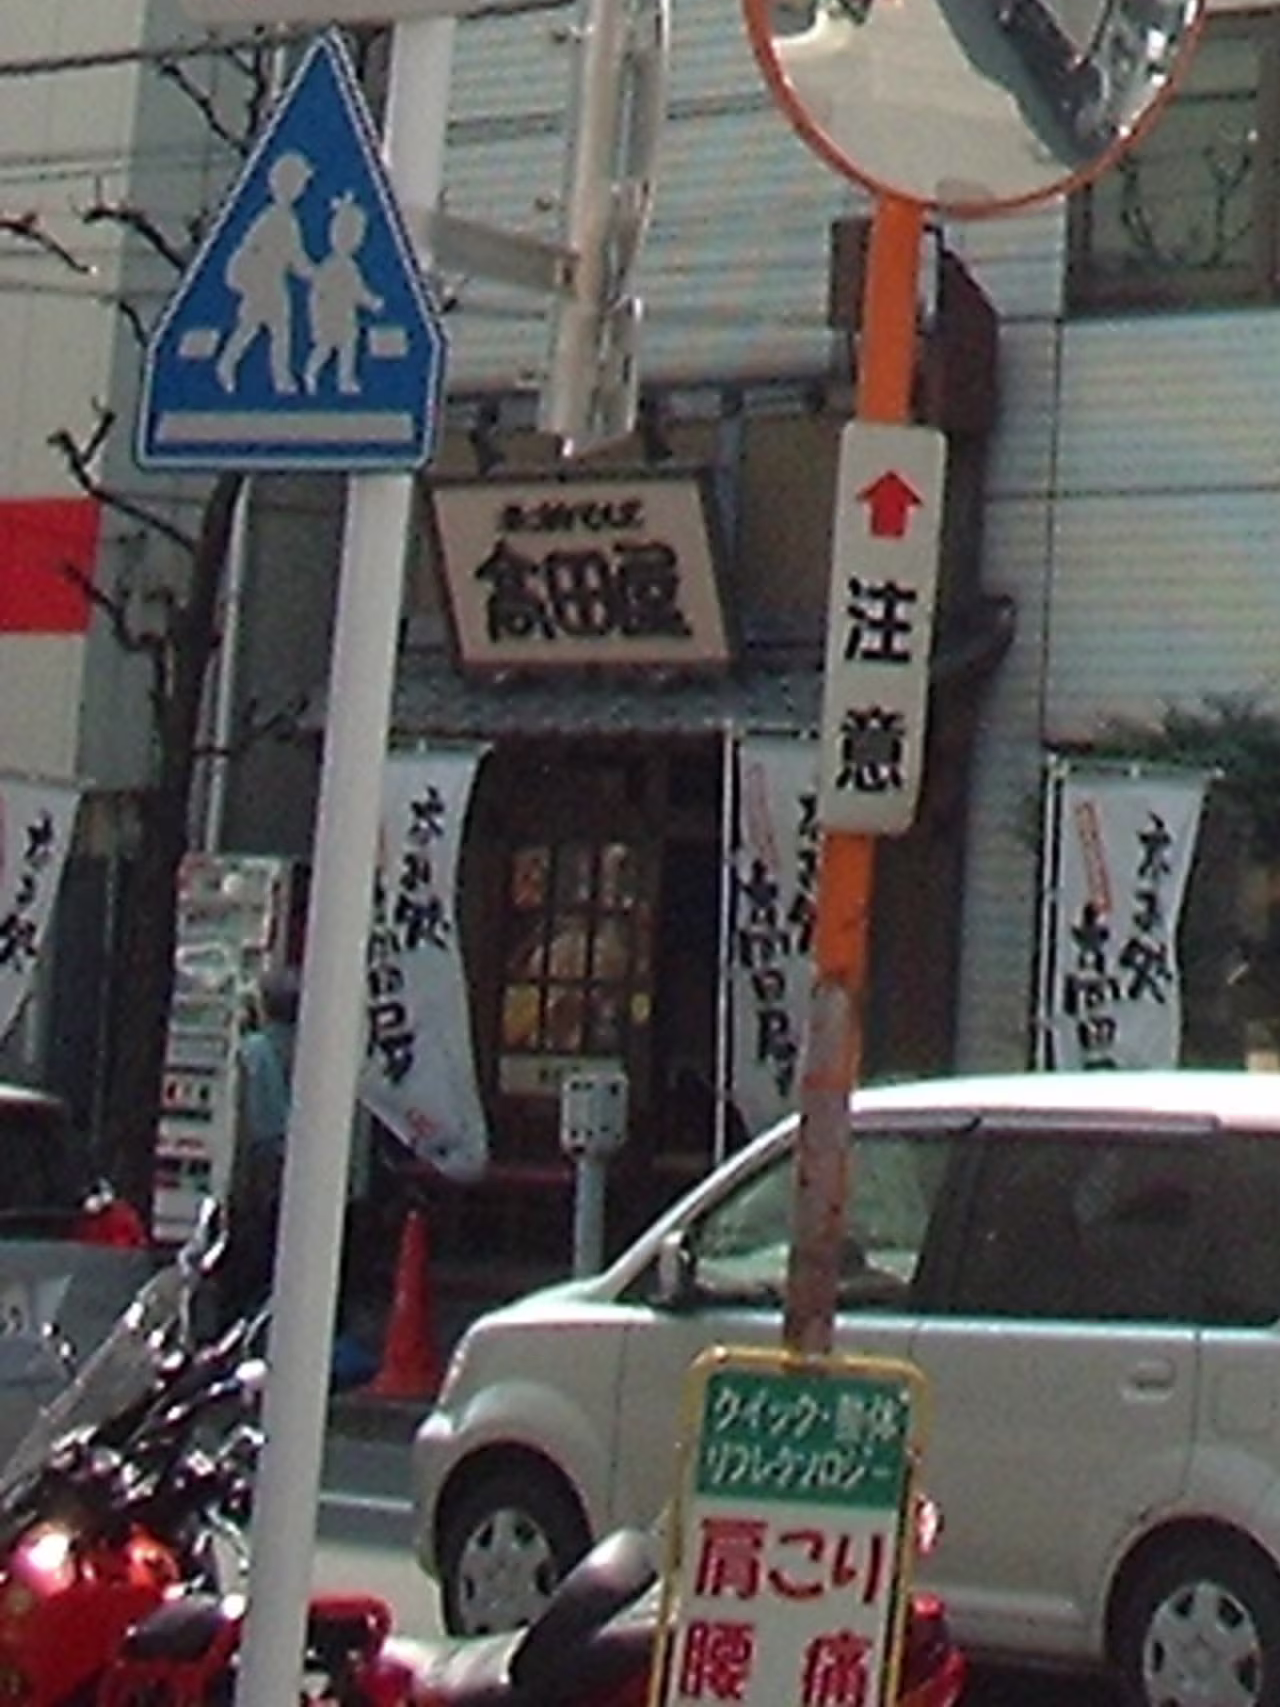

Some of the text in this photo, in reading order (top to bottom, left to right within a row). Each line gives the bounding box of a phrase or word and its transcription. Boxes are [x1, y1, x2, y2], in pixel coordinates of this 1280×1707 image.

[835, 576, 919, 795] 注意
[696, 1517, 885, 1605] 肩こり
